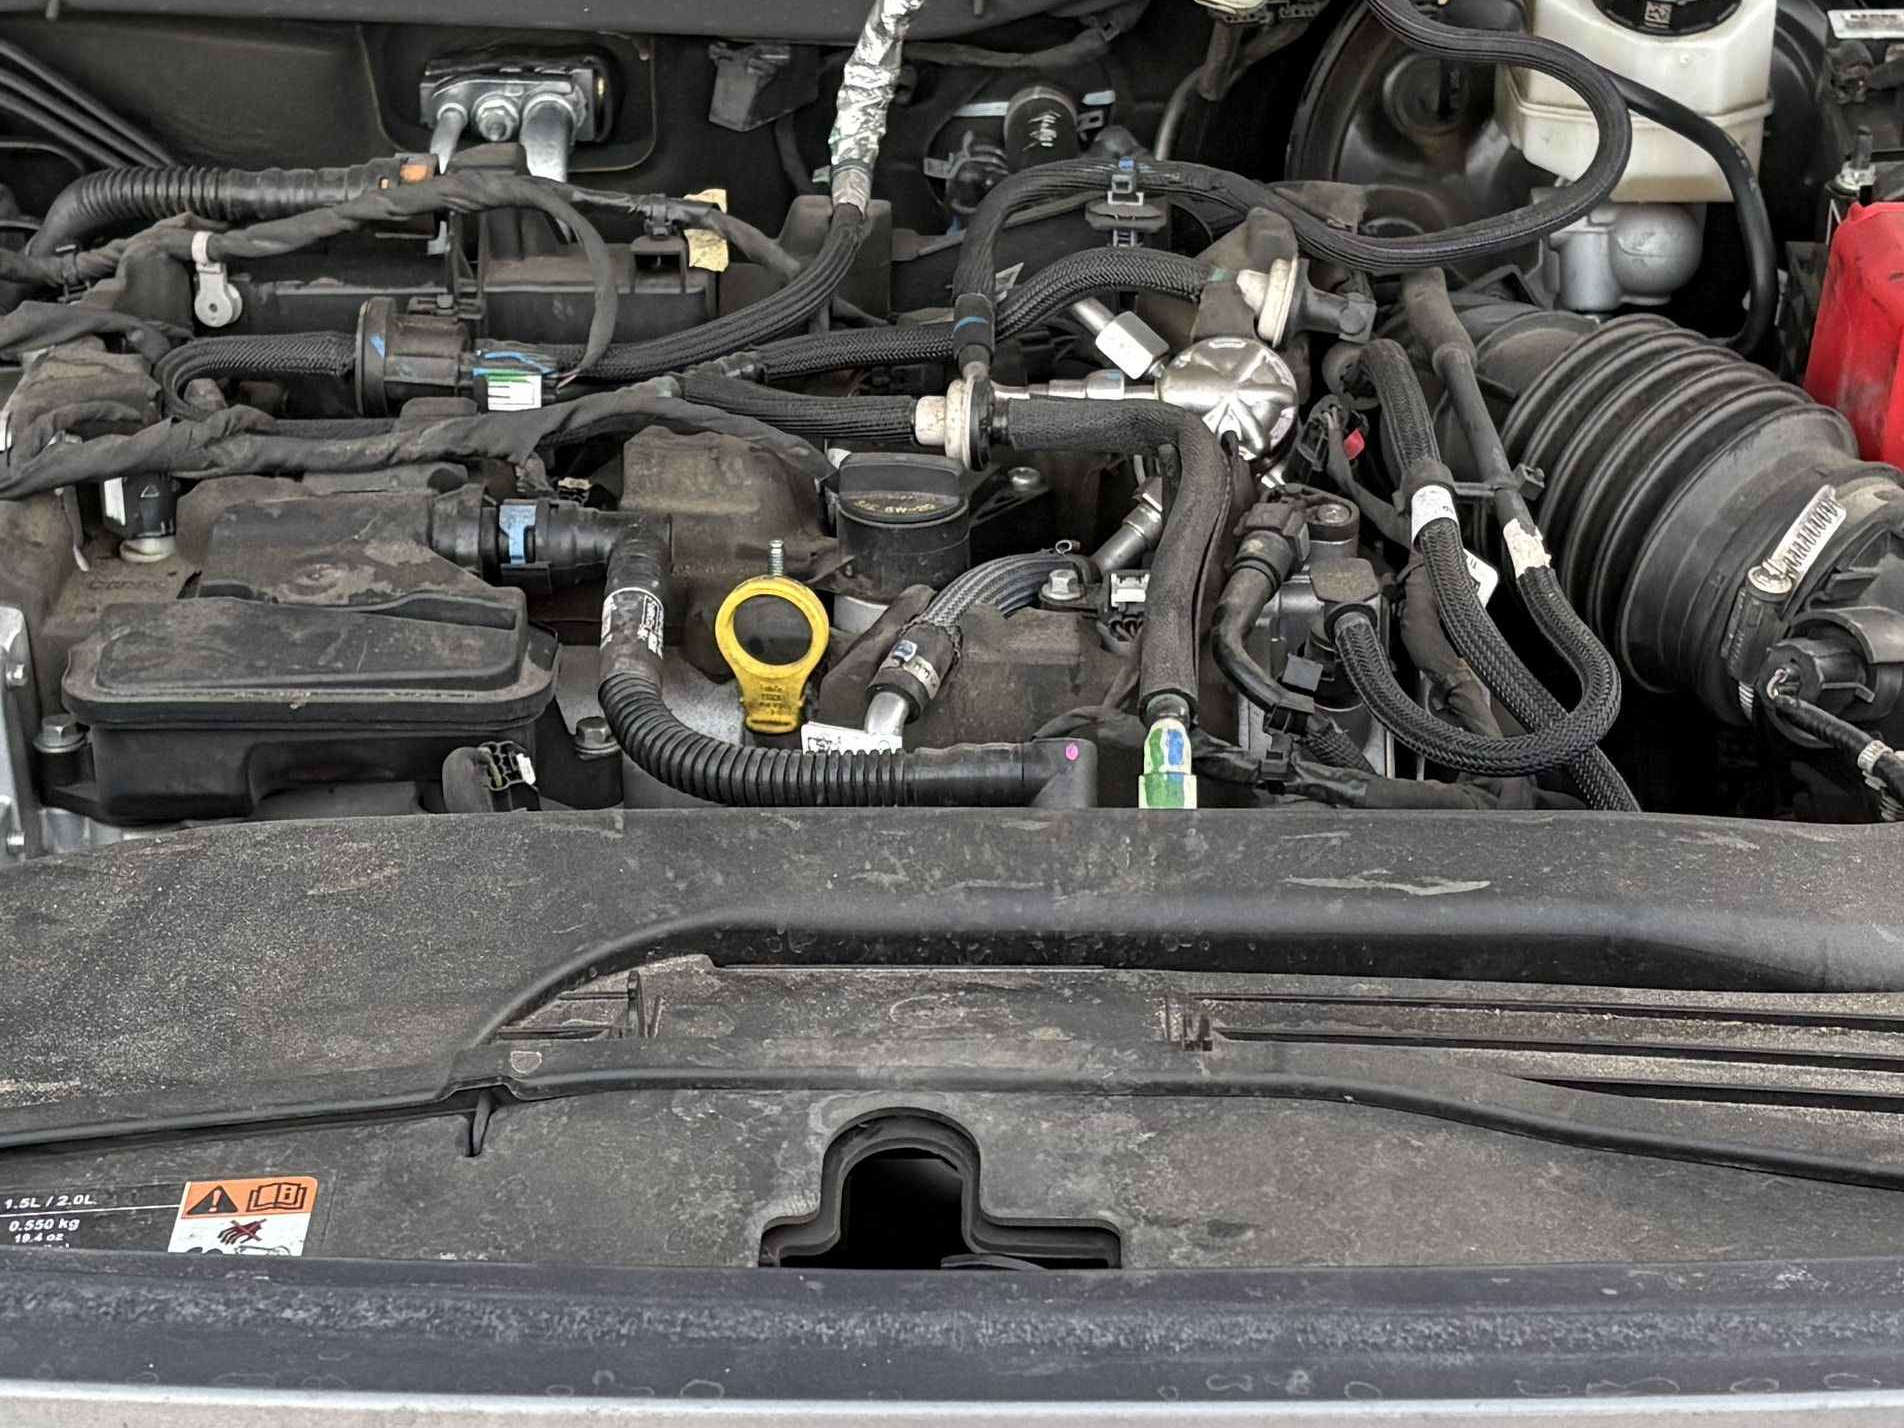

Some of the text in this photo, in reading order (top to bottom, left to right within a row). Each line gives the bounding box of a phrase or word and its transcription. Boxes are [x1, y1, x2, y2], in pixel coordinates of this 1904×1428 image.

[4, 1197, 41, 1210] 1.5L
[56, 1194, 95, 1207] 2.0L
[8, 1217, 81, 1232] 0.550 kg
[46, 1233, 65, 1242] oz
